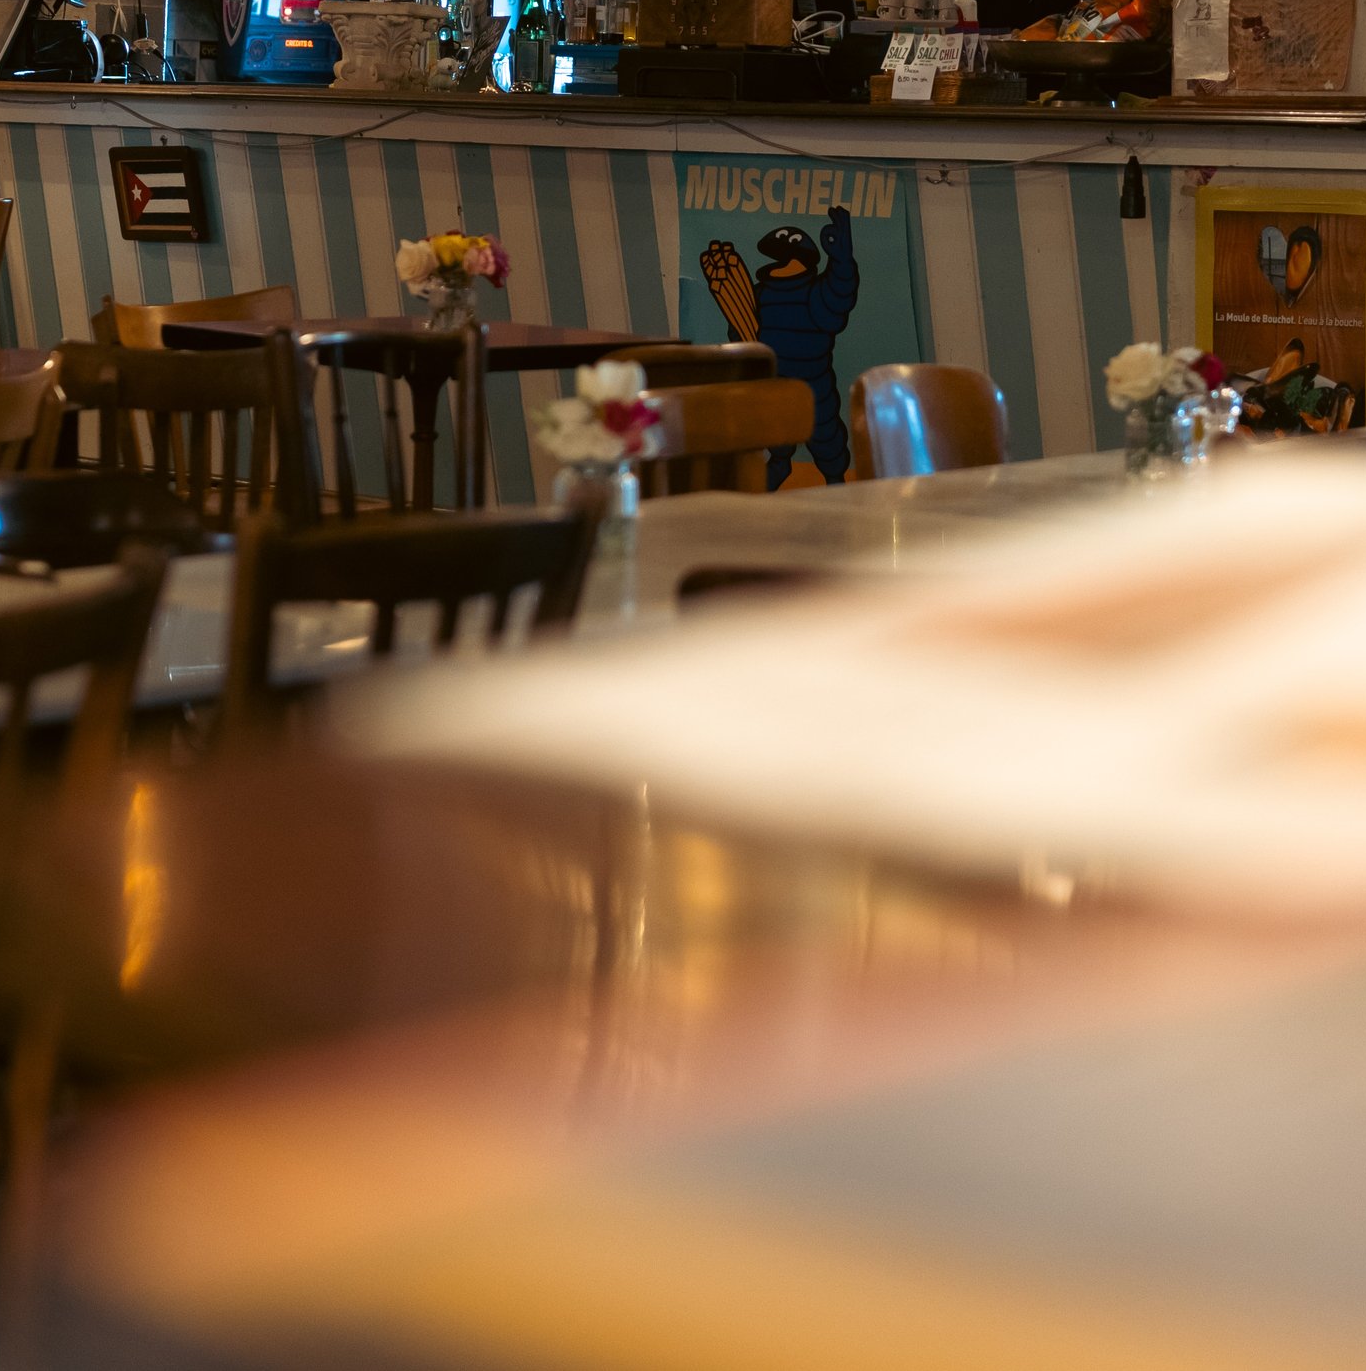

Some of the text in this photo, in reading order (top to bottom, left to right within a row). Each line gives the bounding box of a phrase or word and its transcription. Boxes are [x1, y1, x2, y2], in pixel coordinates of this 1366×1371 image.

[678, 26, 683, 35] 7
[702, 26, 708, 35] 5
[887, 47, 908, 60] SALZ
[917, 47, 939, 60] SALZ
[939, 48, 960, 61] CHILI
[684, 164, 896, 219] MUSCHELIN
[1215, 312, 1365, 328] La Moule de Bouchot. L'eau à la bouche.
